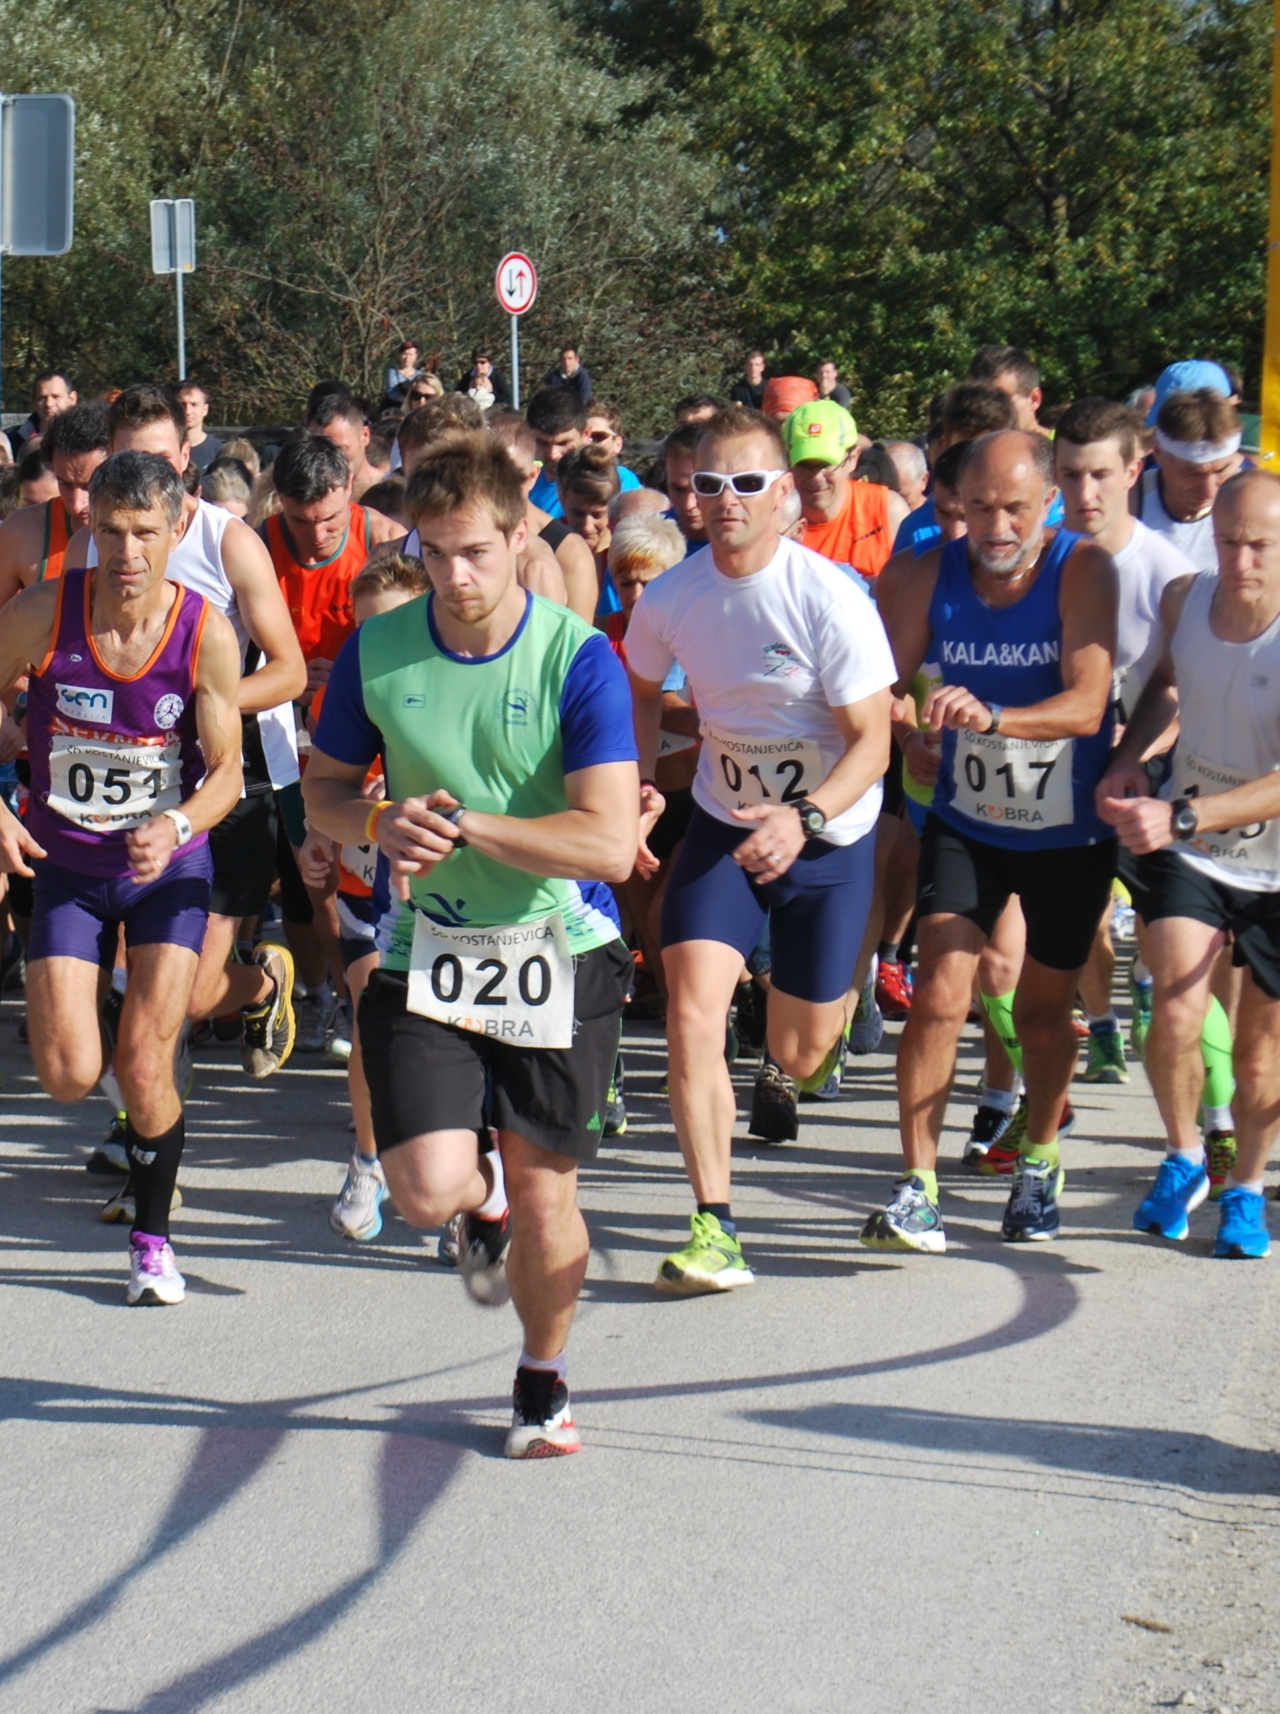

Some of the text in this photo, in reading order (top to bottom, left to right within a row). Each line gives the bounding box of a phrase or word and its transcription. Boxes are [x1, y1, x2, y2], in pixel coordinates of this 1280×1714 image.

[943, 640, 1060, 667] KALA&KAN
[85, 748, 166, 765] KOSTANJEVICA
[68, 763, 162, 805] 051
[720, 753, 809, 803] 012
[965, 753, 1056, 800] 017
[1198, 766, 1248, 787] KOSTANJE
[976, 803, 1044, 823] KOBRA
[431, 953, 552, 1007] 020
